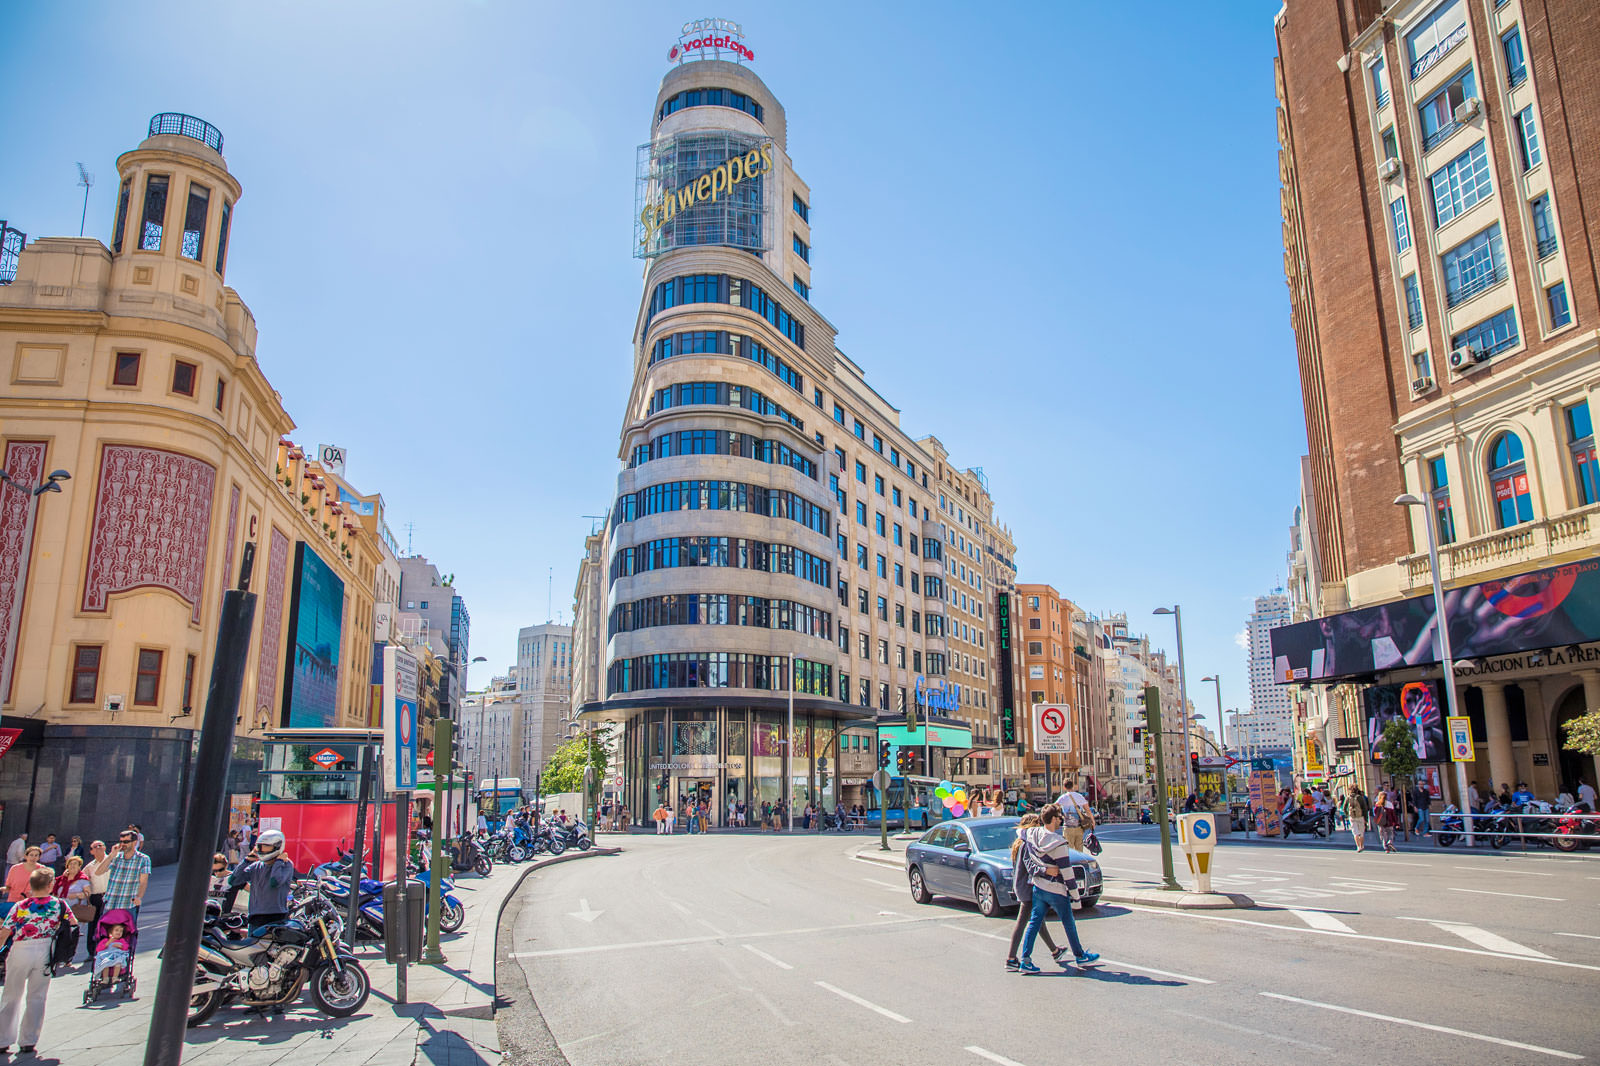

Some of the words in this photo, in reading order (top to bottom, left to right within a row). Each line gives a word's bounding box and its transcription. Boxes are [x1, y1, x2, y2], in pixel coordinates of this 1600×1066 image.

[681, 17, 746, 39] CAPITOL
[683, 34, 754, 61] vodafone
[639, 143, 773, 246] Schweppes
[1496, 487, 1512, 498] PSOE
[999, 596, 1009, 649] HOTEL
[1004, 707, 1014, 741] REX
[1453, 656, 1523, 678] SOCIACION
[1547, 653, 1566, 666] LA
[916, 675, 960, 714] Capitol
[1143, 728, 1151, 778] MPERADOR
[1199, 772, 1221, 784] MAD
[1199, 783, 1221, 794] MAX
